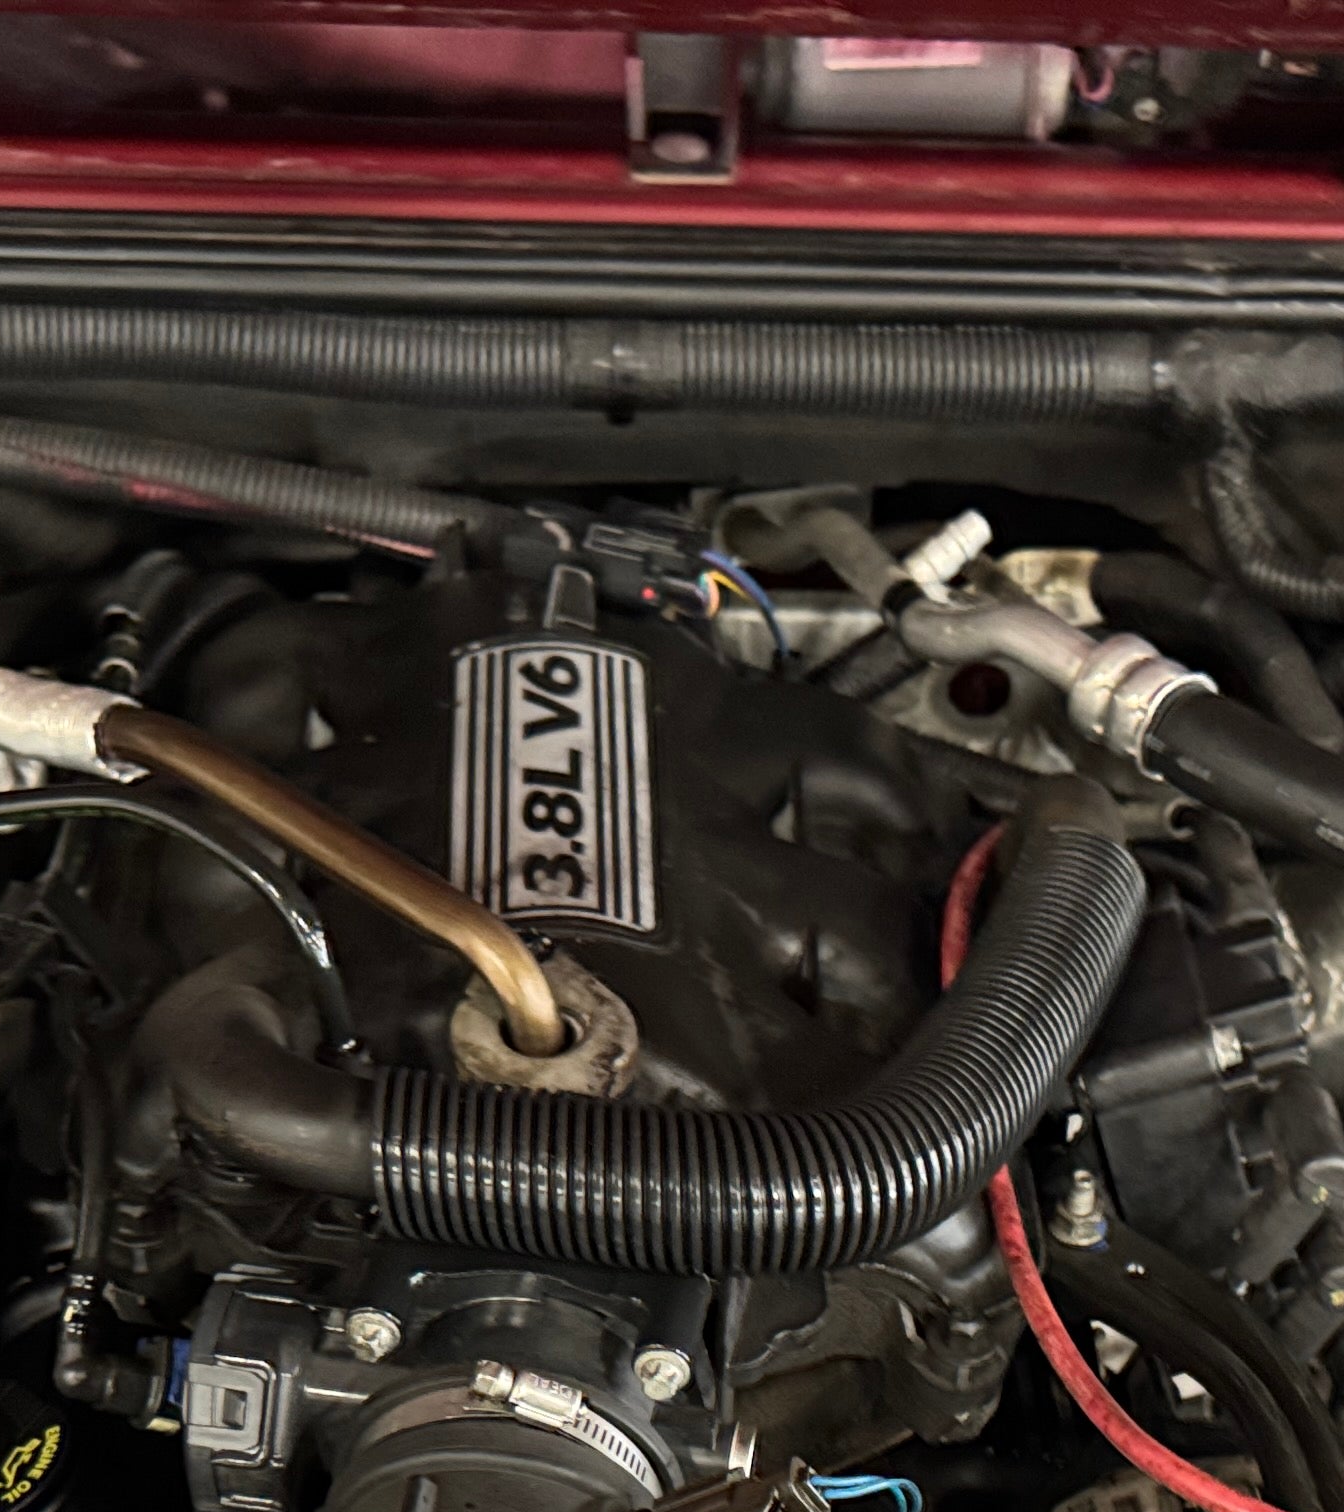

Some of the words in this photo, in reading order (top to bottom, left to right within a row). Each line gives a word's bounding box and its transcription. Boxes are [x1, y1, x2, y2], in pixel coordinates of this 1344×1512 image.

[518, 655, 582, 740] V6
[522, 748, 585, 898] 3.8L
[27, 1425, 61, 1479] ENGINE
[0, 1480, 31, 1503] OIL
